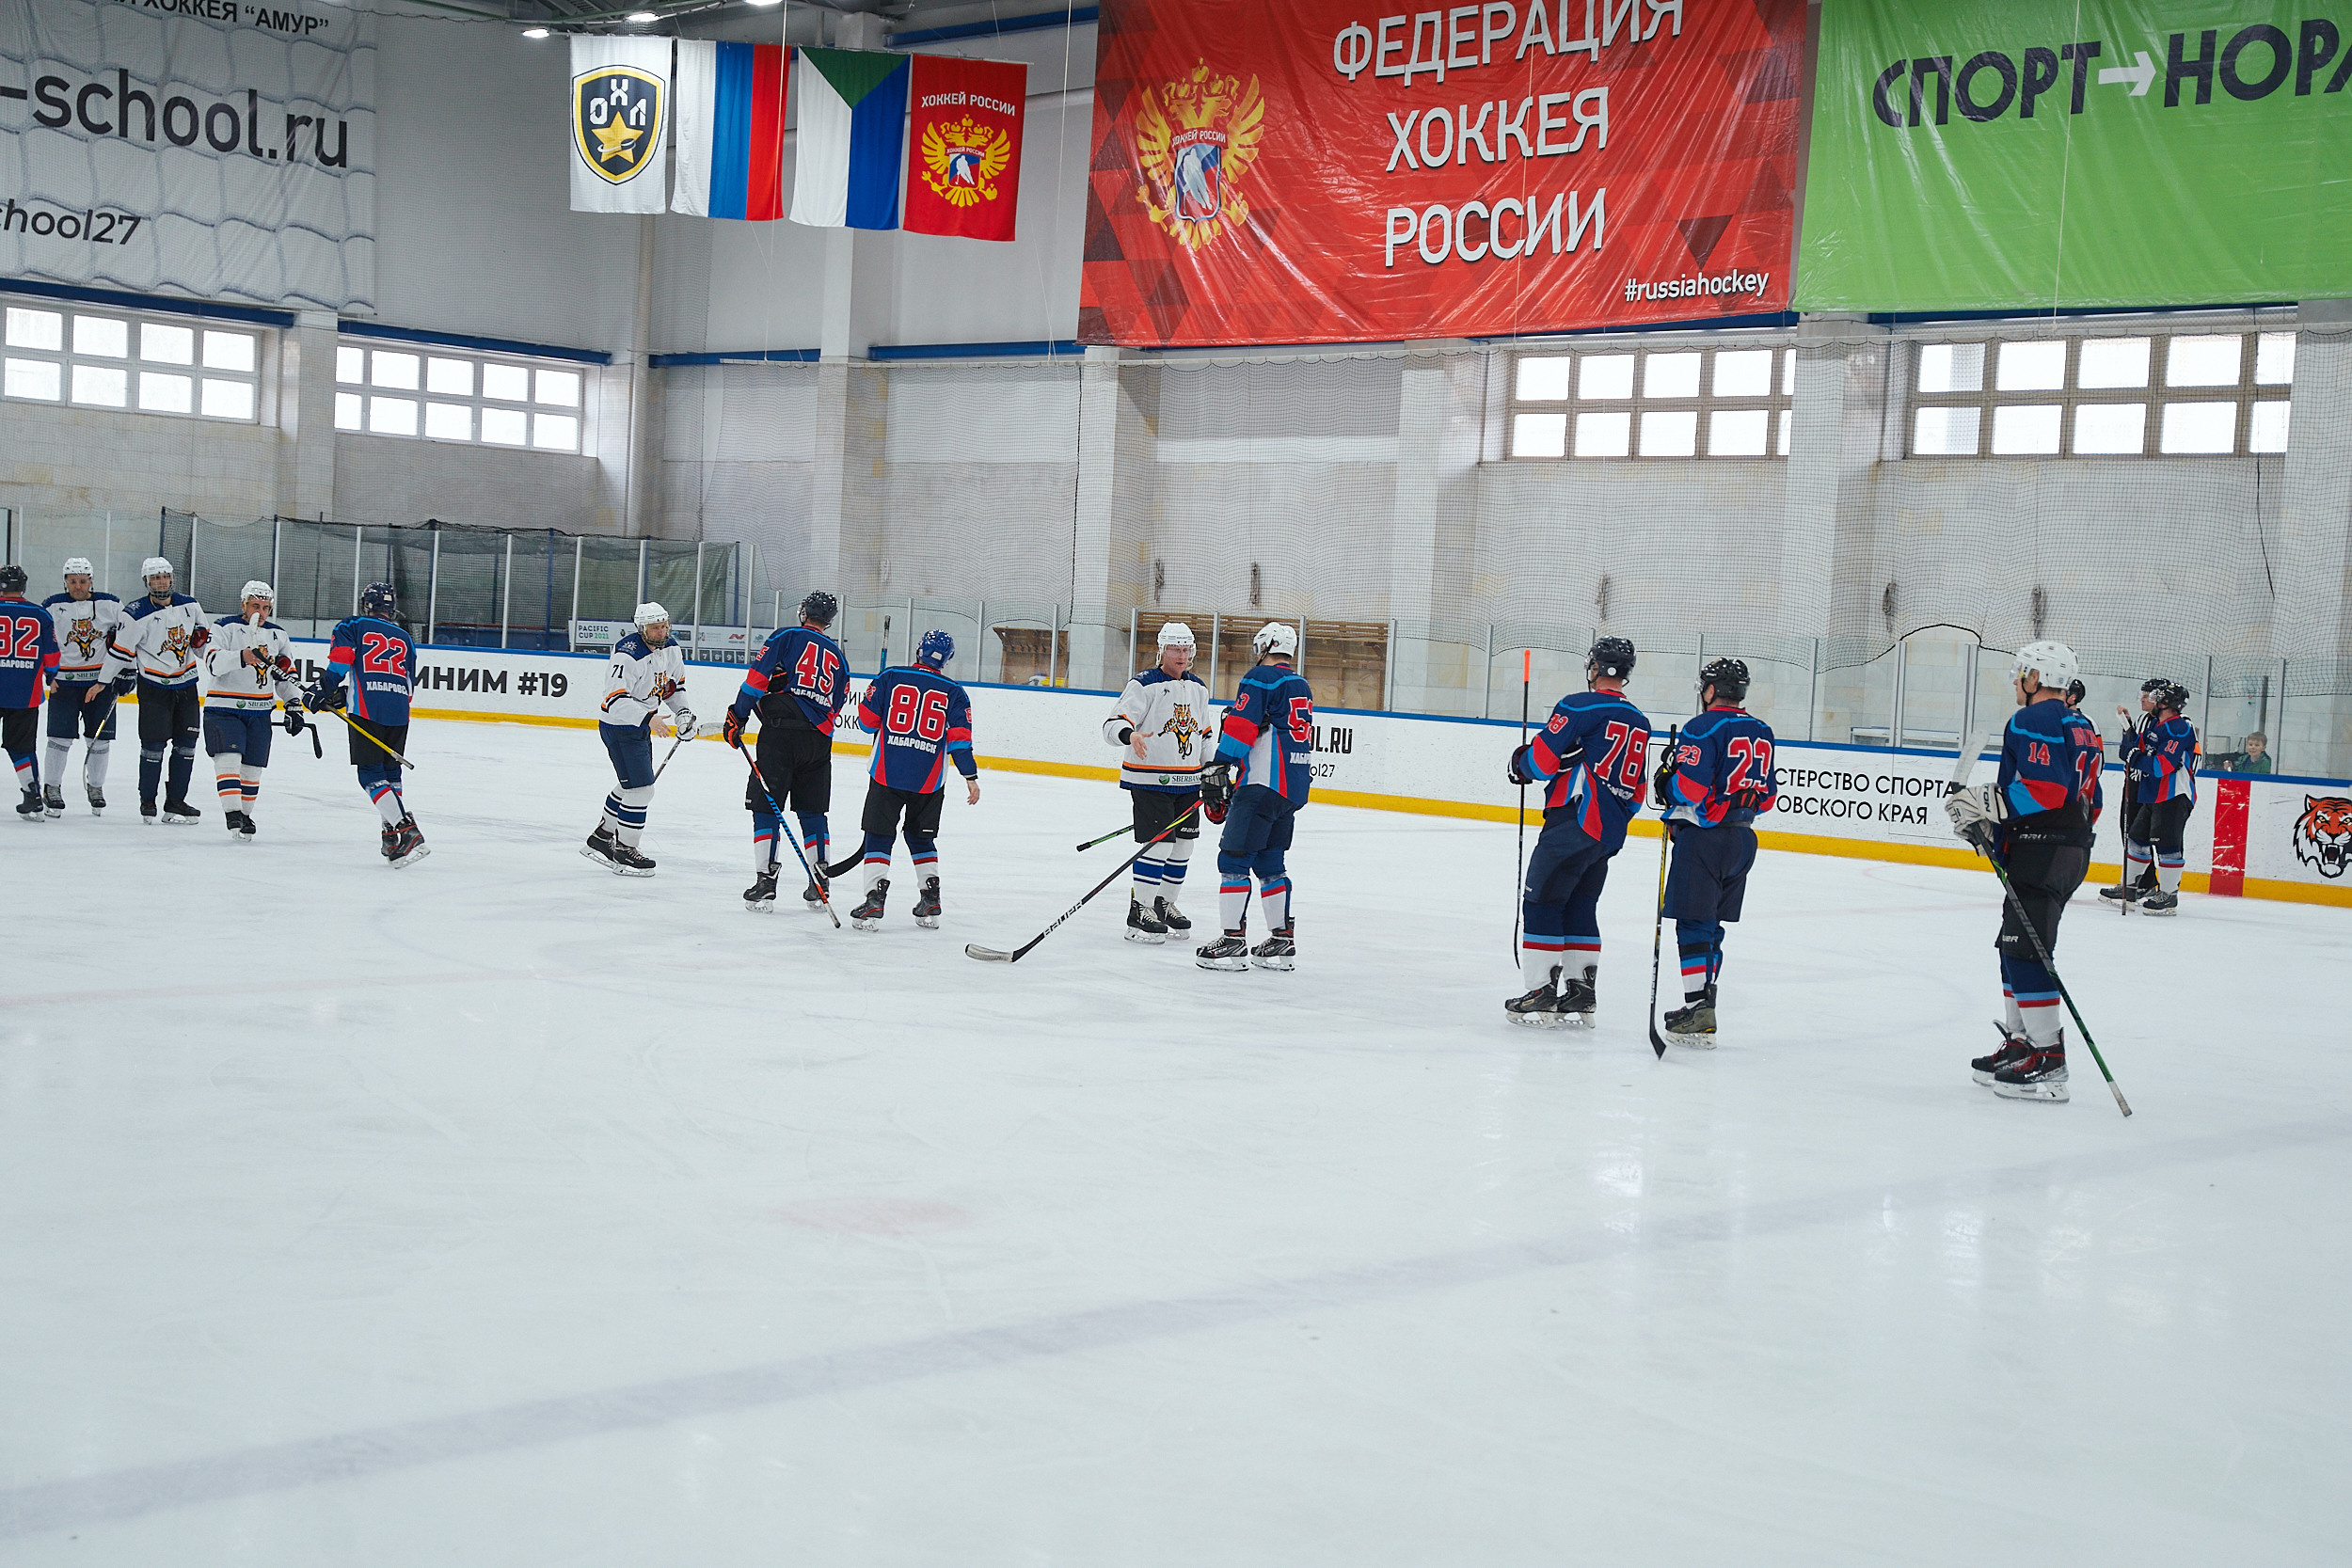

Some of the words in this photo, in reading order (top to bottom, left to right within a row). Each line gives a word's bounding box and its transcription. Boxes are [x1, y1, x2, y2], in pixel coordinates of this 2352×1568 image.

[1333, 0, 1682, 87] ФЕДЕРАЦИЯ
[1872, 40, 2101, 128] СПОРТ
[921, 91, 966, 108] ХОККЕЙ
[970, 94, 1015, 117] РОССИИ
[1172, 129, 1198, 147] ХОККЕЙ
[1200, 131, 1226, 144] РОССИИ
[1386, 86, 1609, 172] ХОККЕЯ
[966, 148, 985, 157] РОССИИ
[0, 198, 141, 245] hool27
[1386, 188, 1606, 267] РОССИИ
[1625, 269, 1770, 302] #russiahockey
[0, 659, 35, 669] БАРОВСК
[363, 631, 408, 679] 22
[796, 641, 840, 695] 45
[517, 672, 568, 698] #19
[612, 664, 624, 678] 71
[886, 684, 949, 742] 86
[887, 735, 937, 753] ХАБАРОВСК
[1594, 721, 1647, 790] 78
[1677, 745, 1702, 767] 23
[2027, 742, 2050, 767] 14
[2165, 740, 2179, 754] 11
[1310, 764, 1335, 778] ol27
[1724, 736, 1772, 796] 23
[1774, 768, 1870, 793] СТЕРСТВО
[1875, 775, 1955, 799] СПОРТА
[1776, 795, 1873, 820] ОВСКОГО
[1878, 803, 1928, 825] КРАЯ
